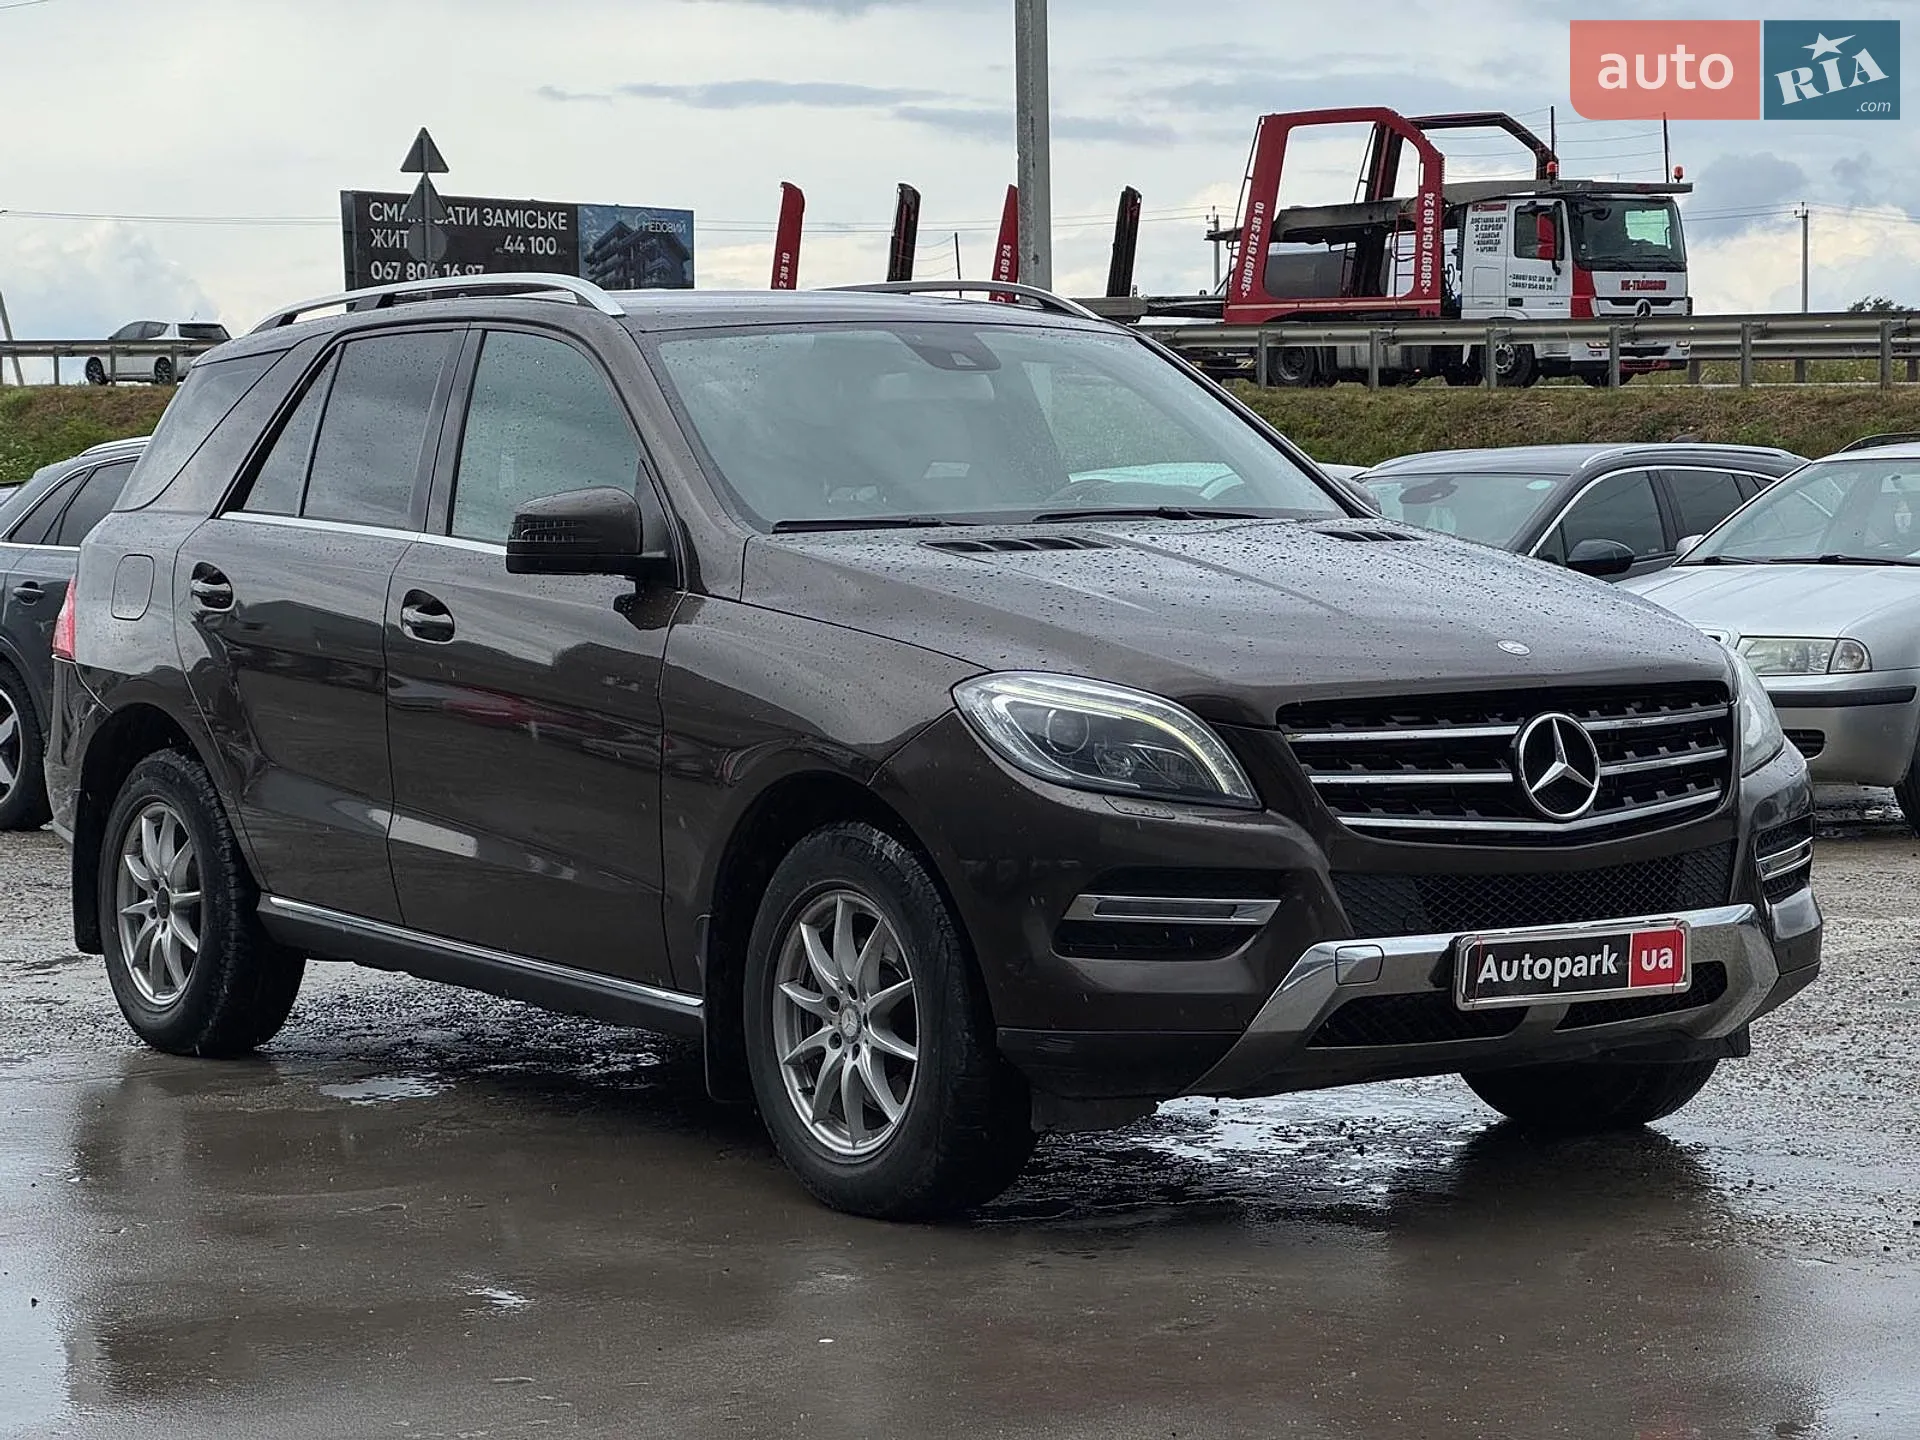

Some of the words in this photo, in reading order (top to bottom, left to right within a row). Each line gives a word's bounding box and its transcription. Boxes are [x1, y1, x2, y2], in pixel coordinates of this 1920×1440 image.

[1253, 201, 1265, 215] 10
[1424, 192, 1436, 207] 24
[369, 202, 478, 226] СМААТИ
[483, 208, 567, 230] ЗАМІСЬКЕ
[1251, 216, 1263, 232] 38
[1423, 208, 1435, 225] 09
[370, 228, 409, 249] ЖИТ
[504, 235, 525, 254] 44
[528, 236, 557, 255] 100
[1247, 232, 1260, 255] 612
[1422, 226, 1434, 249] 054
[782, 252, 791, 264] 10
[370, 261, 401, 280] 067
[1240, 254, 1256, 298] +38097
[1420, 251, 1433, 295] +38097
[1477, 944, 1618, 987] Autopark
[1641, 946, 1673, 971] ua
